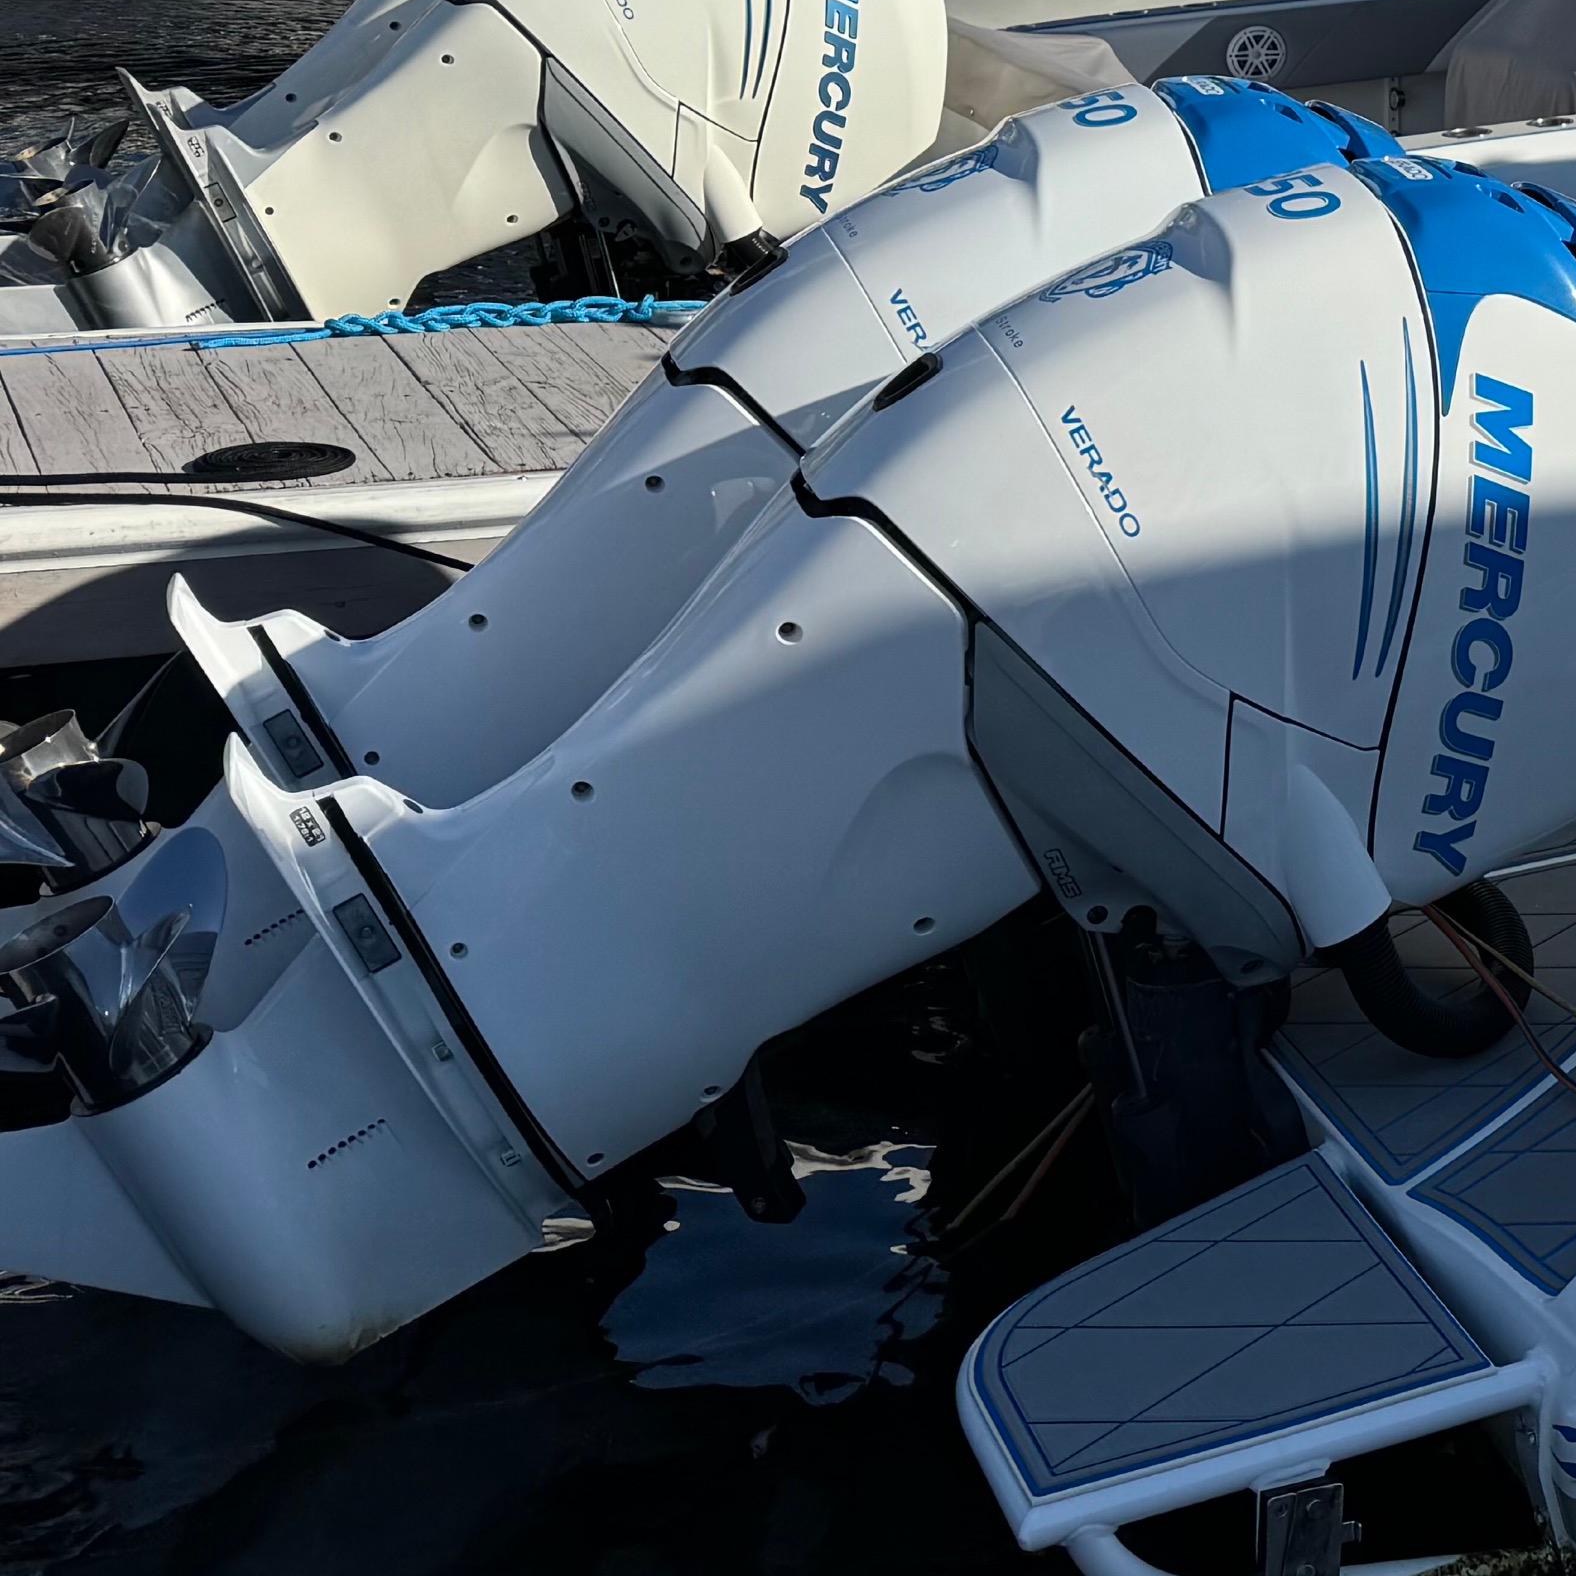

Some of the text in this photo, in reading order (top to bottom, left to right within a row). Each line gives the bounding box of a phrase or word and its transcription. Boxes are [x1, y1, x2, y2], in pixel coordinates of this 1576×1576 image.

[890, 288, 930, 352] VER
[1061, 405, 1141, 538] VERADO
[1413, 372, 1534, 878] MERCURY
